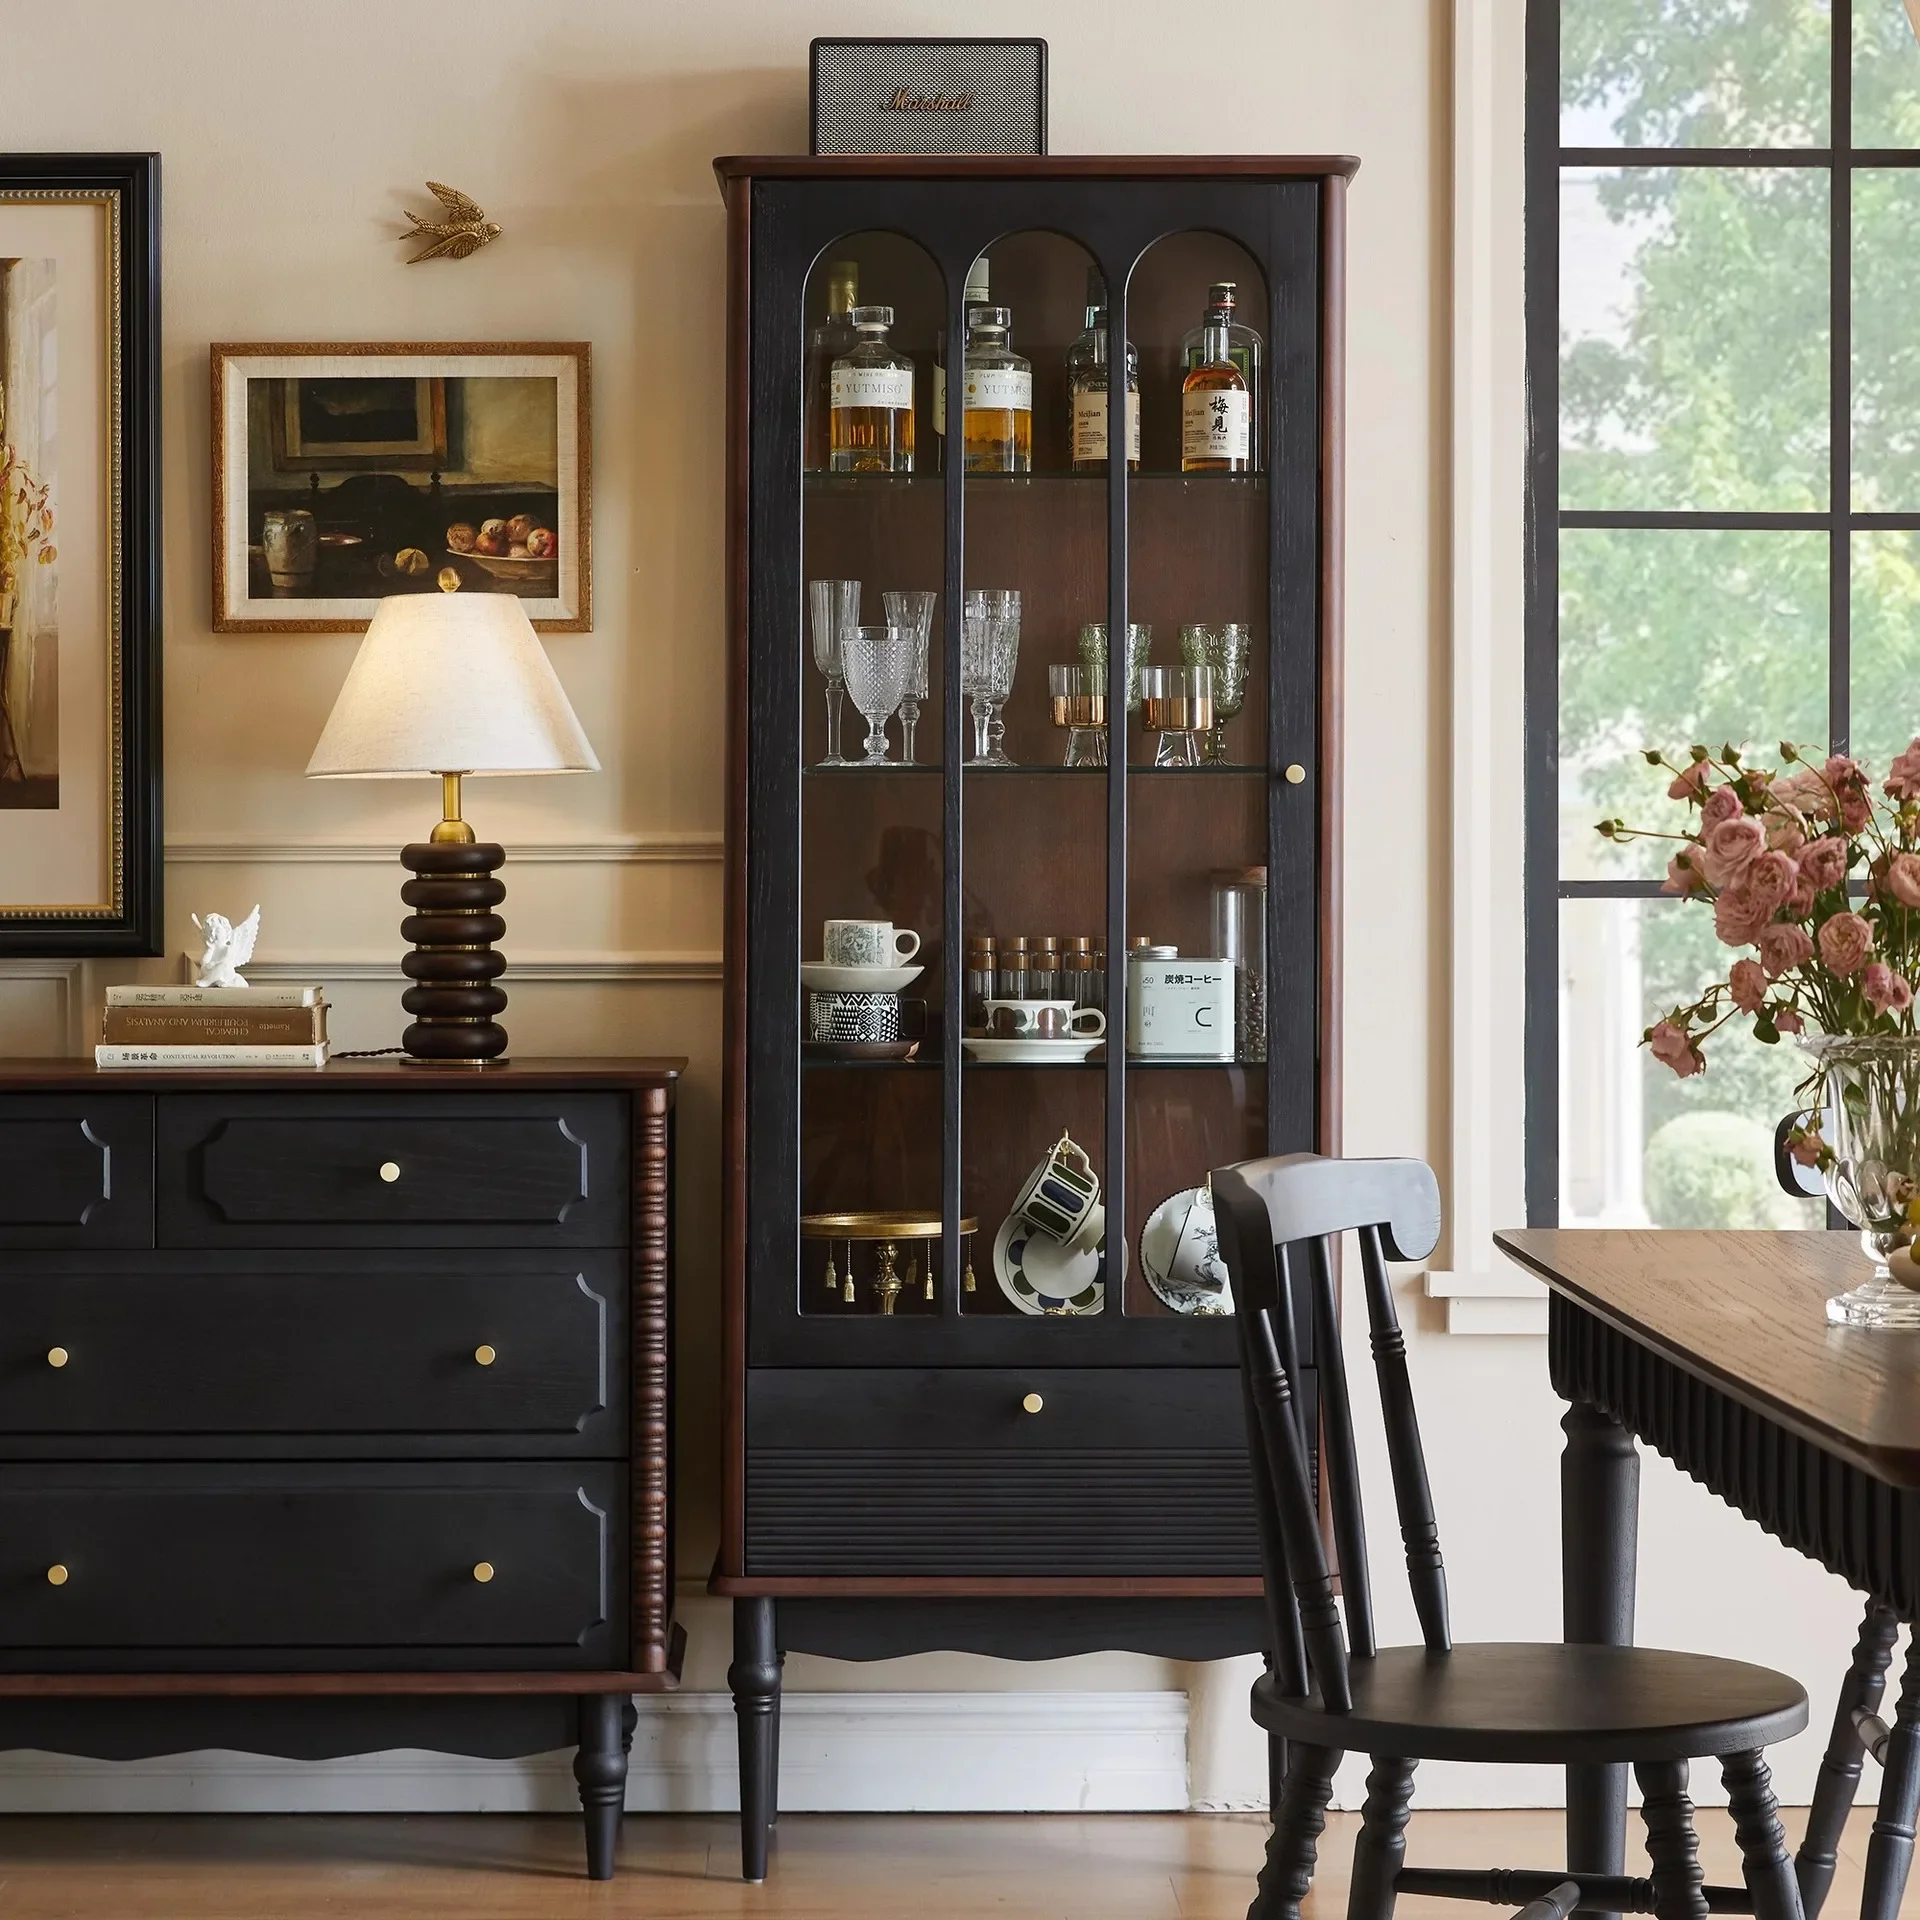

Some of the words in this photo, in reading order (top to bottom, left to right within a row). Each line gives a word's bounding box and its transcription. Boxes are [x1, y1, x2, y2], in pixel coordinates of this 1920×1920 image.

[883, 86, 976, 110] Marshall
[1164, 974, 1222, 984] 炭焼コーヒー
[126, 1017, 167, 1026] ANALYSIS
[168, 1018, 188, 1026] AND
[191, 1018, 249, 1028] EQUILIBRIUM
[259, 1023, 290, 1031] Ramette
[205, 1028, 249, 1036] CHEMICAL
